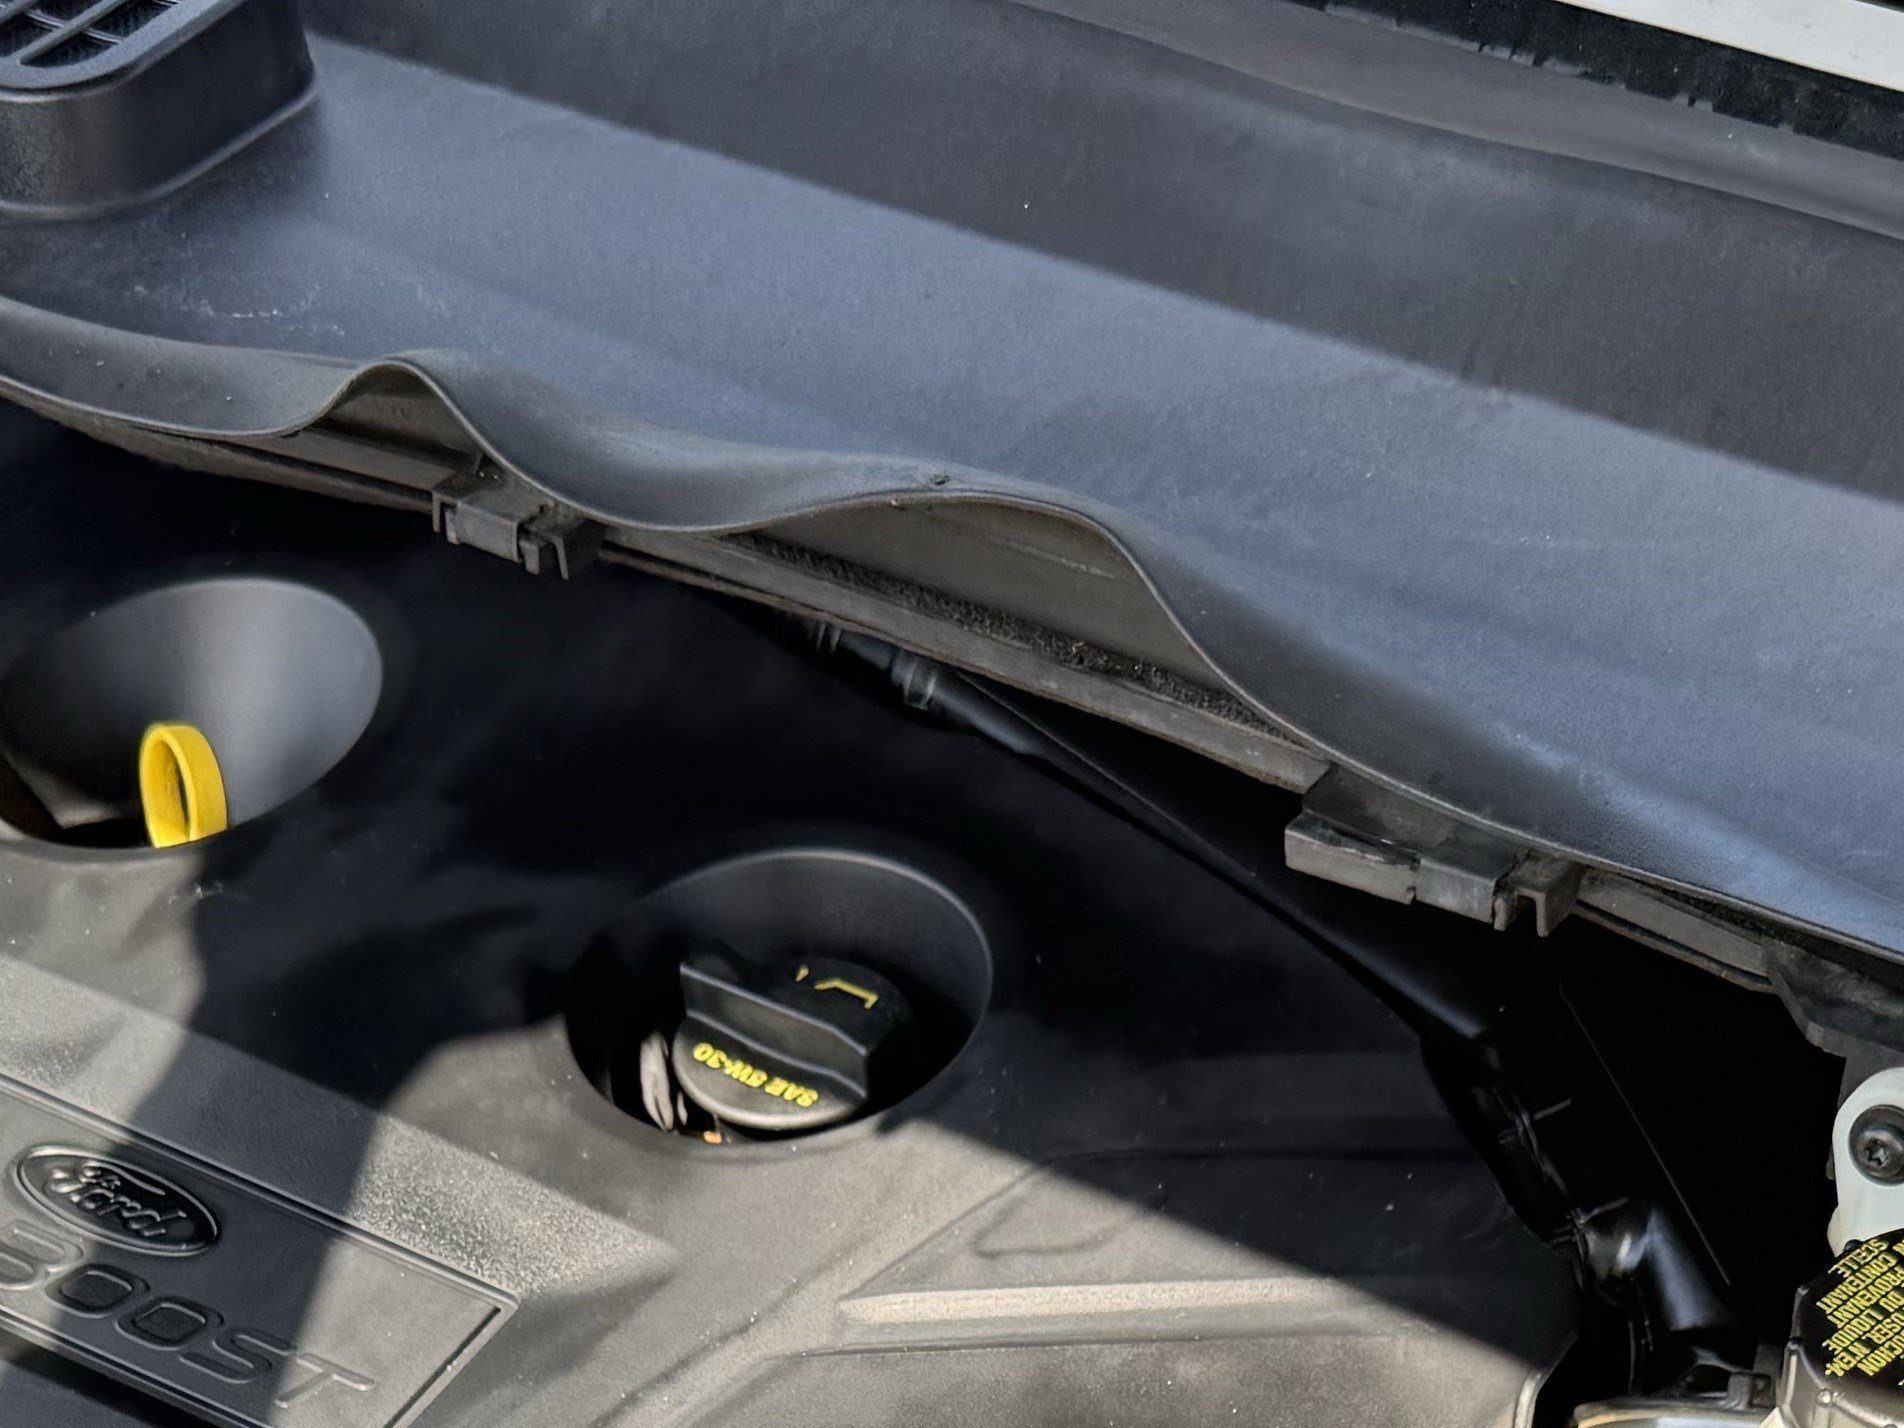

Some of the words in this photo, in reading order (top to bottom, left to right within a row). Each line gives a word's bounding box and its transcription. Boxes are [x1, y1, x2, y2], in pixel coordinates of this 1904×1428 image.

[764, 1074, 820, 1109] SAE
[44, 1160, 188, 1240] Ford
[1816, 1252, 1896, 1314] CONTENANT
[1822, 1308, 1883, 1354] LIQUIDE
